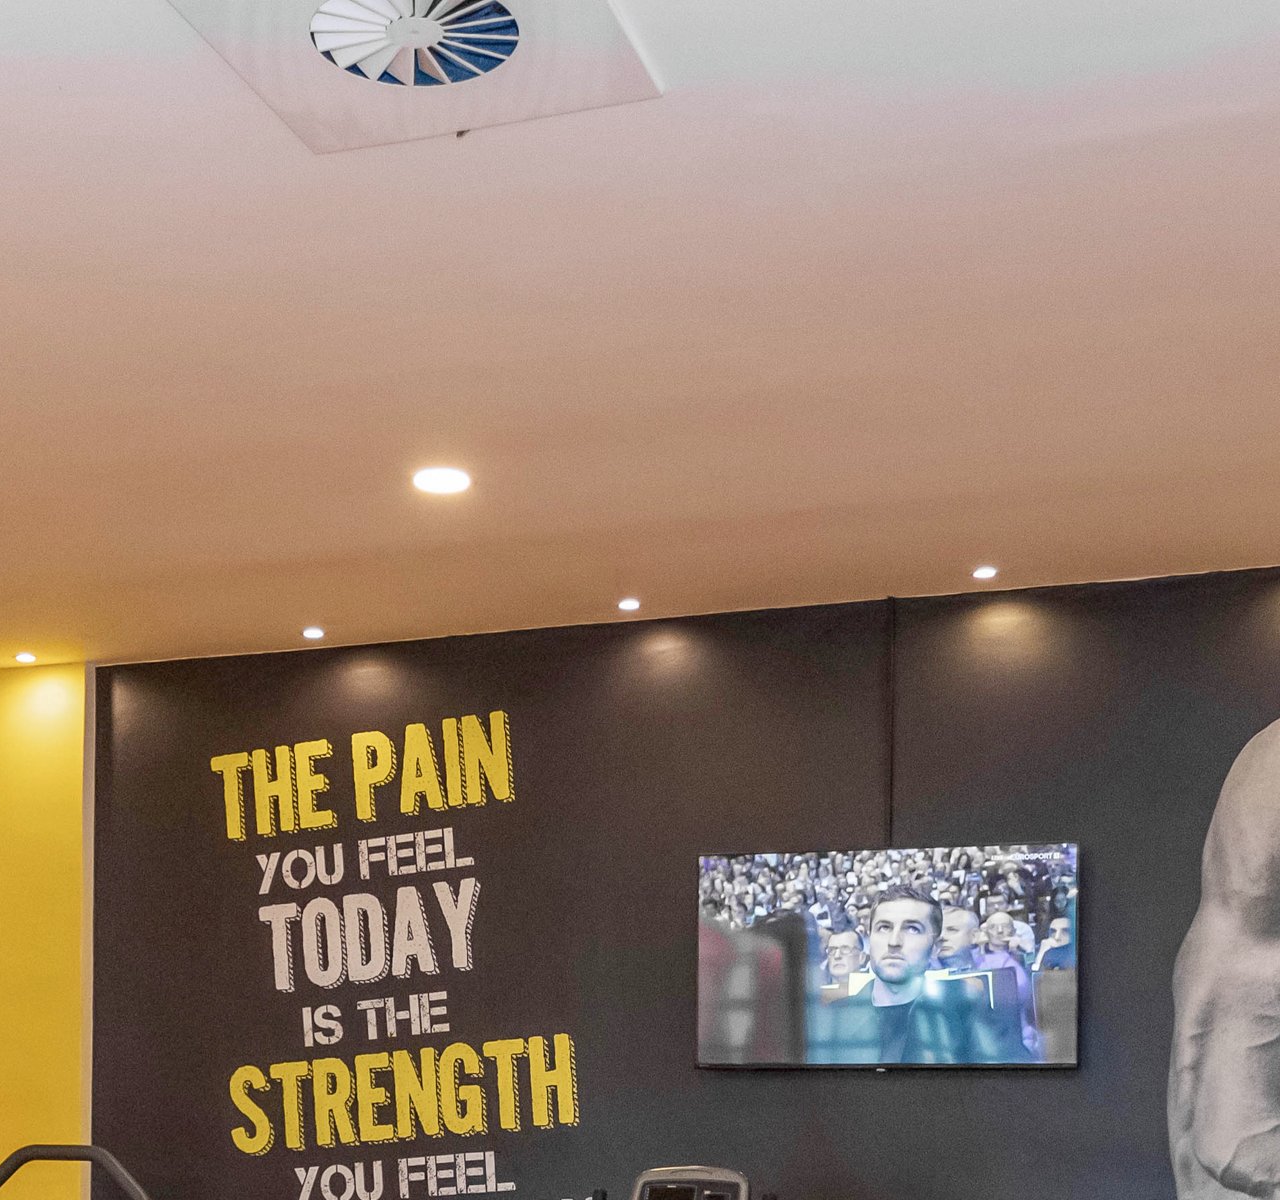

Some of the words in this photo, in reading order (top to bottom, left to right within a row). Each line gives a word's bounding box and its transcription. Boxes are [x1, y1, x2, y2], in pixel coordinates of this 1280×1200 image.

[210, 739, 337, 841] THE
[351, 710, 515, 823] PAIN
[255, 842, 345, 895] YOU
[358, 827, 475, 880] FEEL
[259, 877, 482, 993] TODAY
[302, 1005, 344, 1047] IS
[357, 991, 450, 1040] THE
[229, 1033, 580, 1156] STRENGTH
[397, 1151, 517, 1197] FEEL
